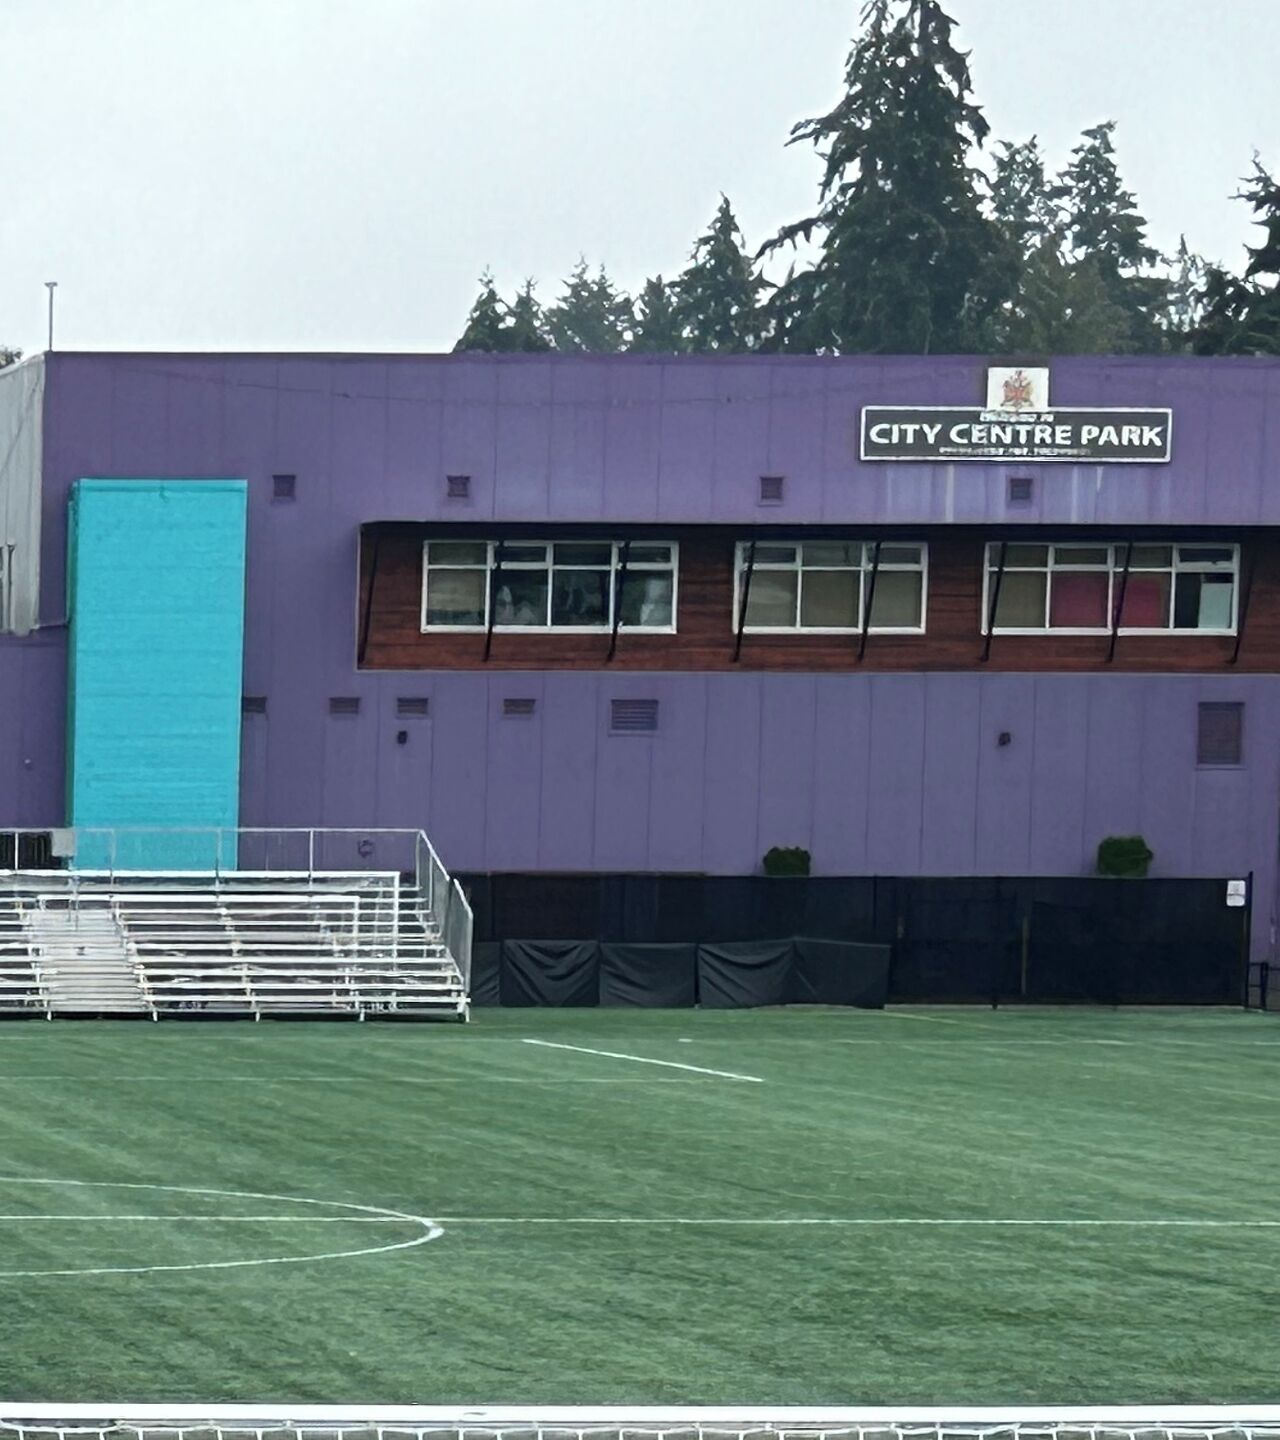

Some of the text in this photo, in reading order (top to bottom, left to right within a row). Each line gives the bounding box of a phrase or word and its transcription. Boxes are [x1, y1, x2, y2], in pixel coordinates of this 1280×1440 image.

[869, 422, 1164, 448] CITY CENTRE PARK
